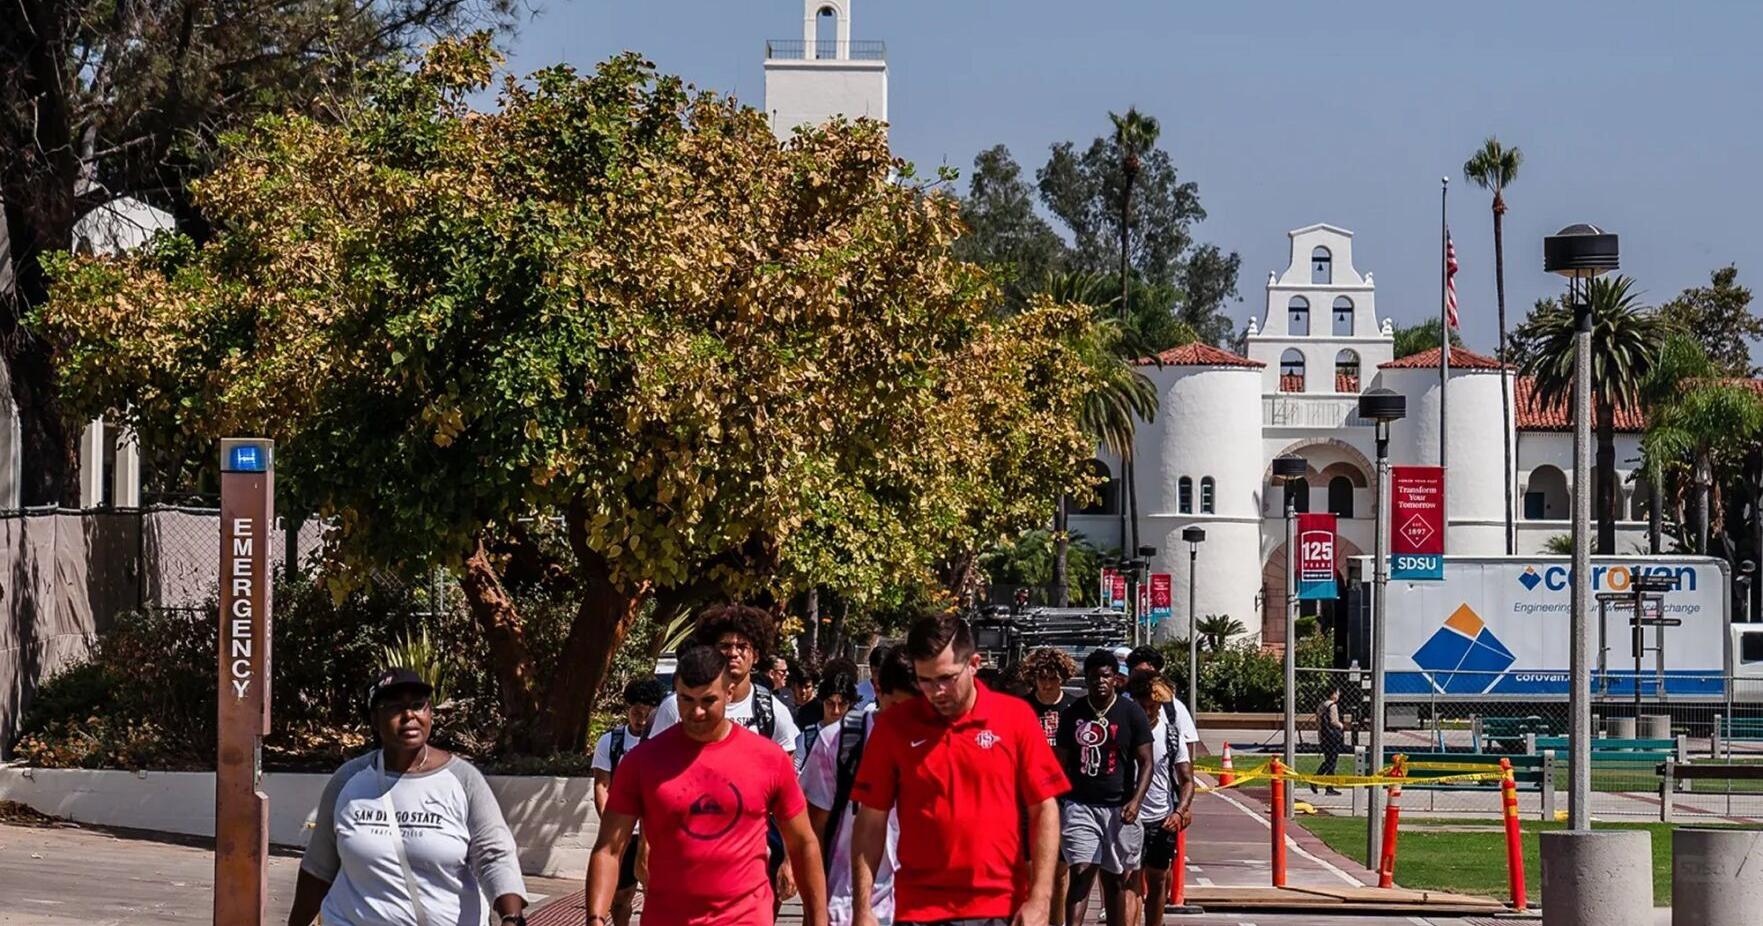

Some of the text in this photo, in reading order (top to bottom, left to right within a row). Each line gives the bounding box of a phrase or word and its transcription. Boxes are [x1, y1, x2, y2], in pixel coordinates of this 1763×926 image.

[1398, 485, 1437, 494] Transform
[1302, 541, 1332, 560] 125
[1398, 556, 1437, 570] SDSU
[1545, 565, 1697, 591] cron
[231, 518, 253, 698] EMERGENCY
[1515, 673, 1594, 682] corovan.
[354, 809, 442, 825] SAN DIGO STATE
